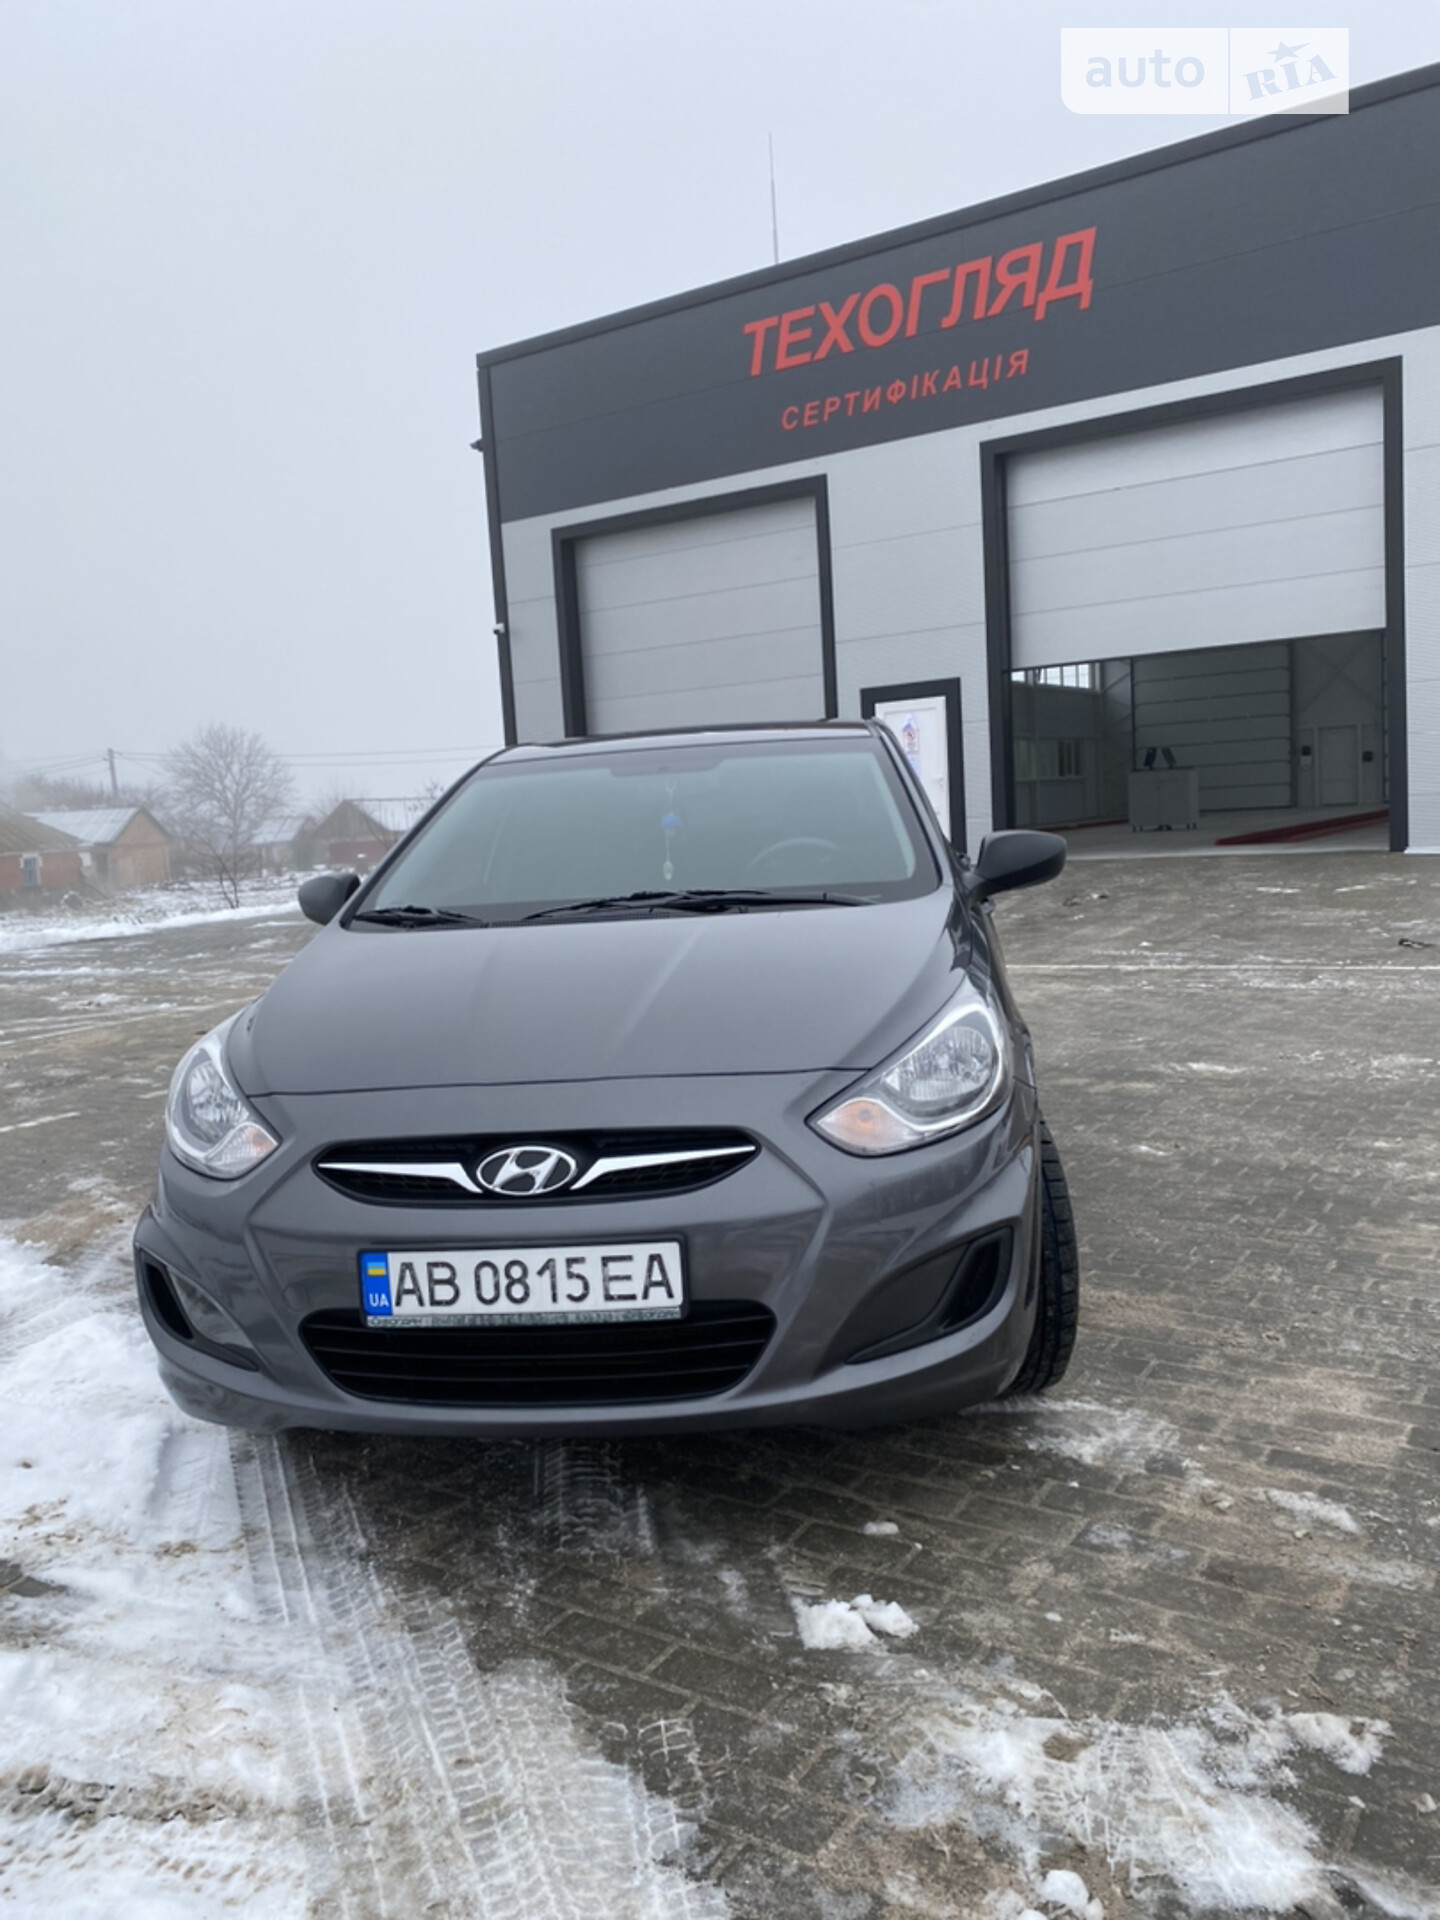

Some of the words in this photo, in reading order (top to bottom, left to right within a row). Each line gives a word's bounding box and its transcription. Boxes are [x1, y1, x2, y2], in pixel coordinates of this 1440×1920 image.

[743, 227, 1097, 377] ТЕХОГЛЯД
[781, 349, 1029, 430] СЕРТИФІКАЦІЯ
[369, 1293, 389, 1307] UA
[394, 1261, 460, 1307] AB
[473, 1257, 590, 1305] 0815
[602, 1253, 674, 1302] EA
